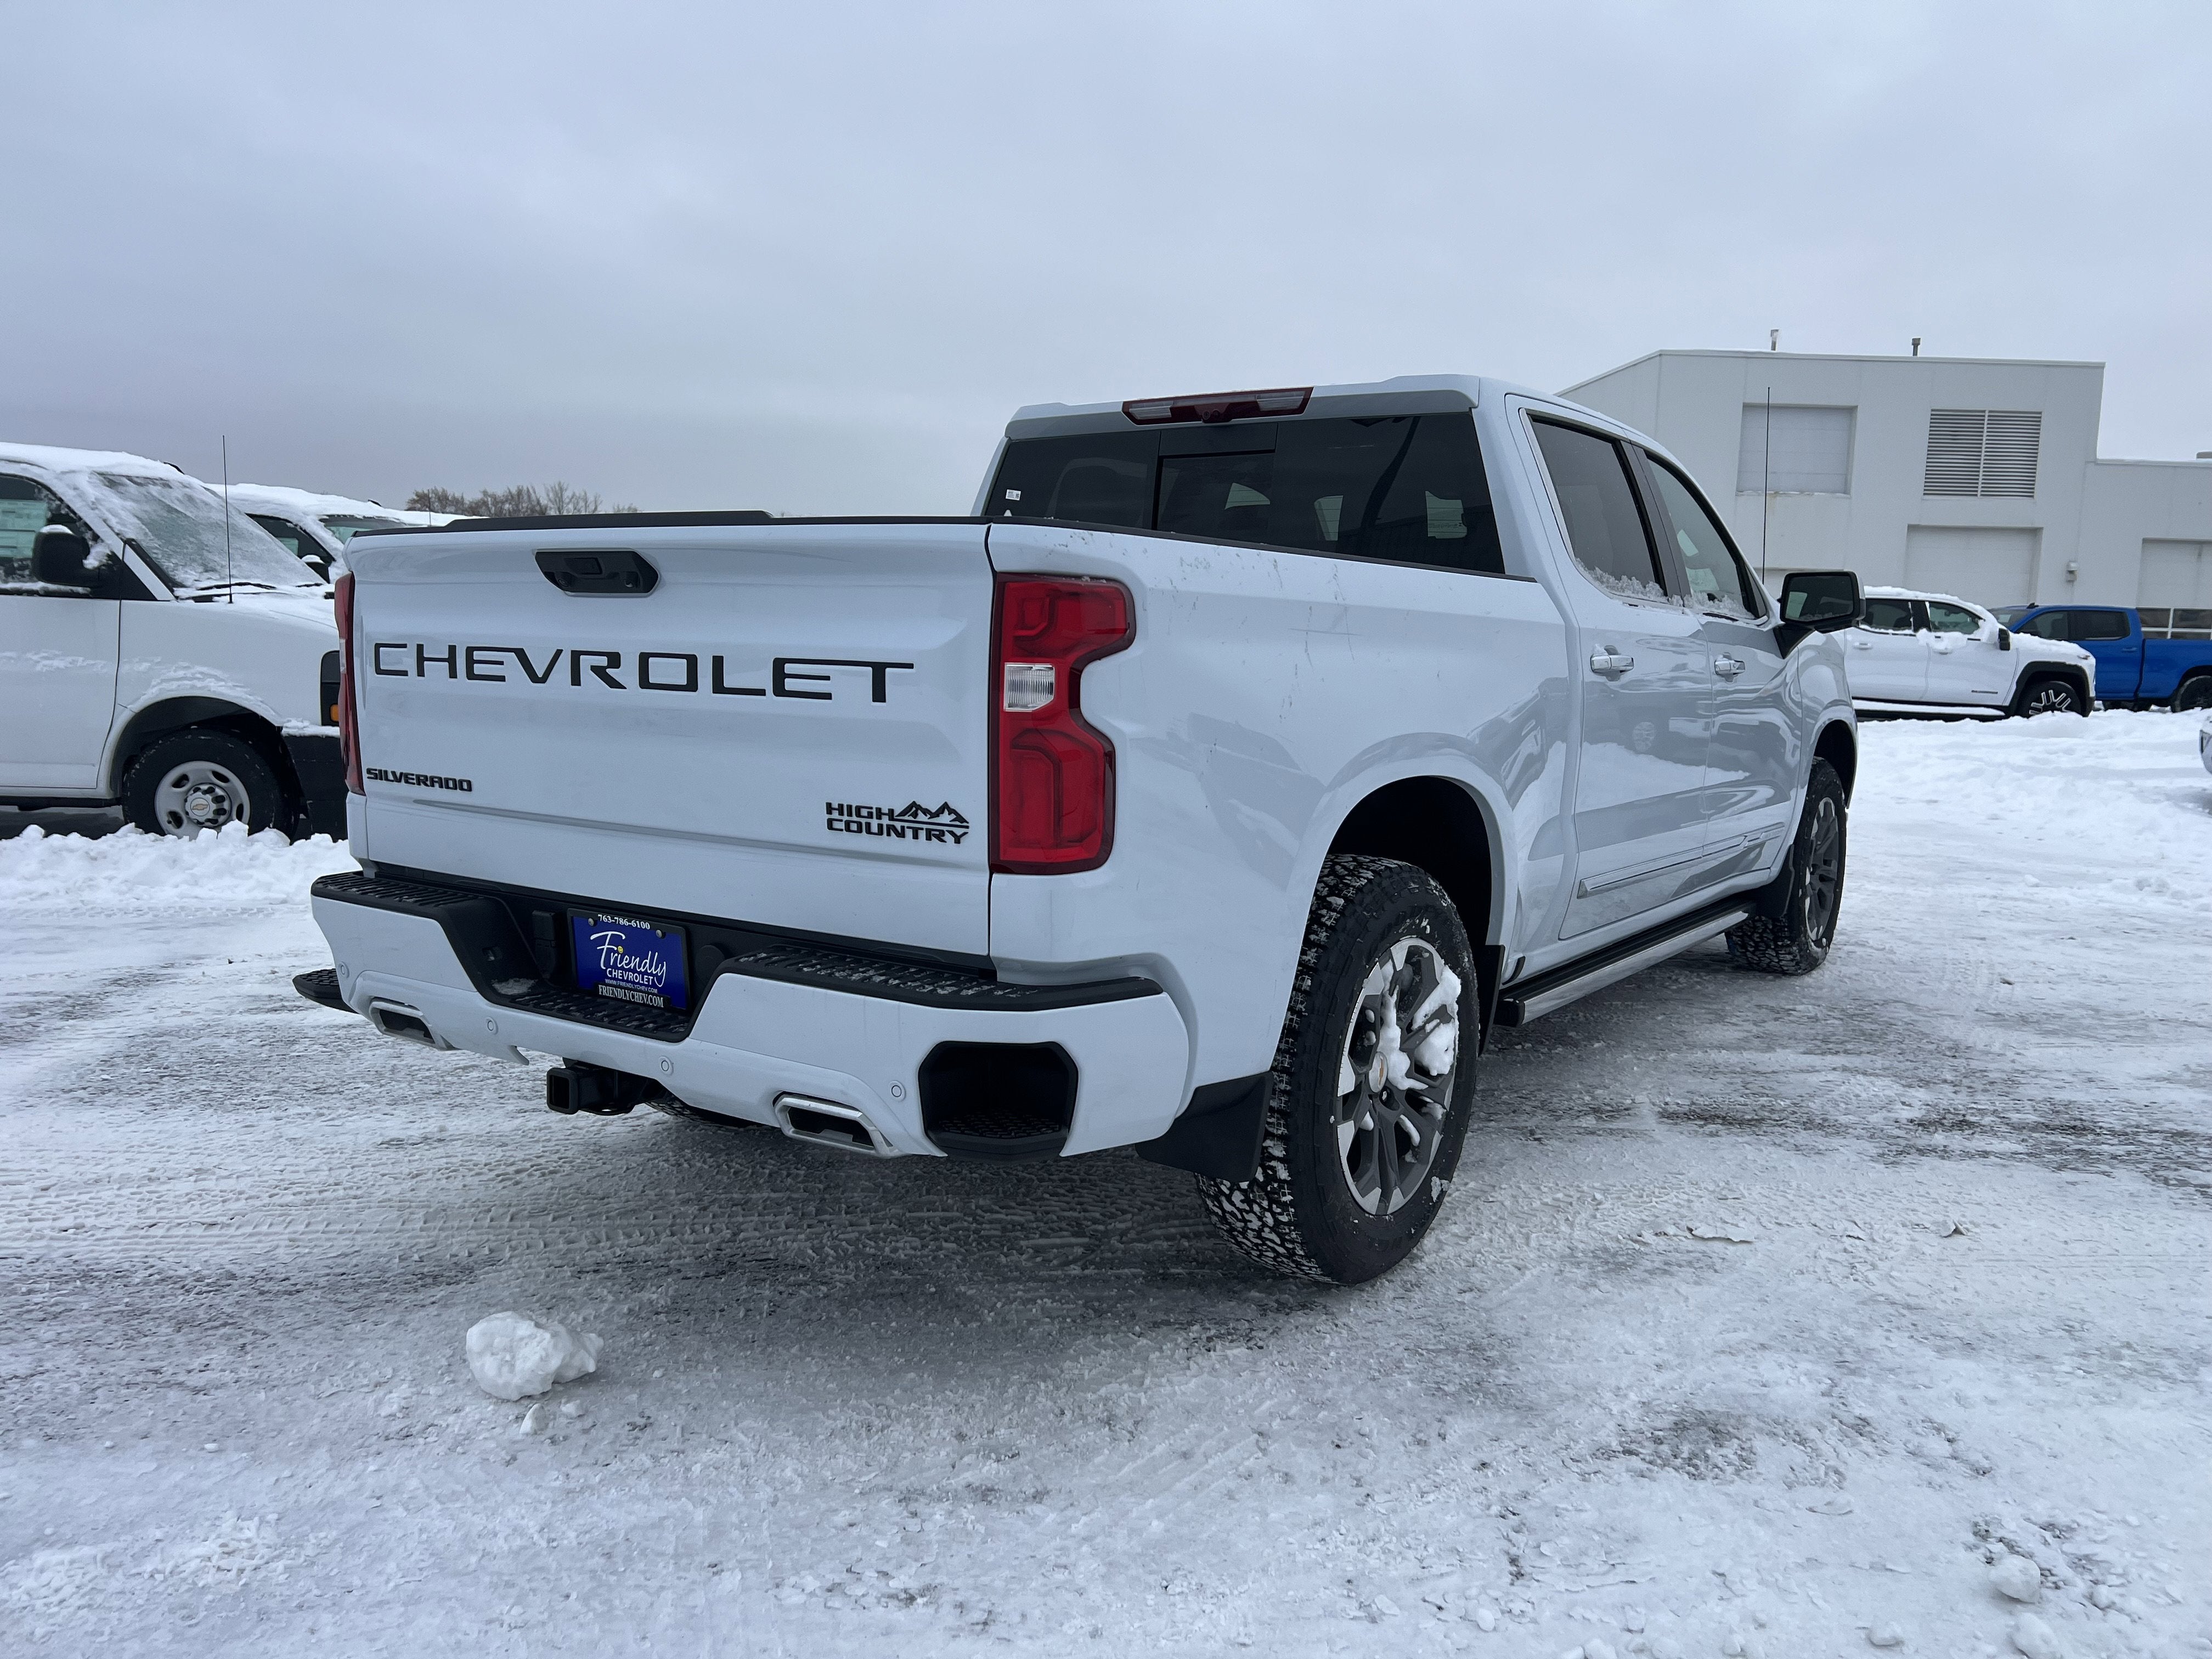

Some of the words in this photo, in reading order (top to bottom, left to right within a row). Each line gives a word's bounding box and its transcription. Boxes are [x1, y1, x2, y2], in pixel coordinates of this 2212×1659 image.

[374, 642, 914, 703] CHEVROLET
[366, 768, 472, 792] SILVERADO
[826, 802, 895, 821] HIGH
[826, 817, 969, 844] COUNTRY
[597, 914, 650, 930] 763-786-6100
[590, 931, 666, 987] Friendly
[607, 968, 653, 985] CHEVROLET
[599, 985, 664, 1008] FRIENDLYCHEV.COM
